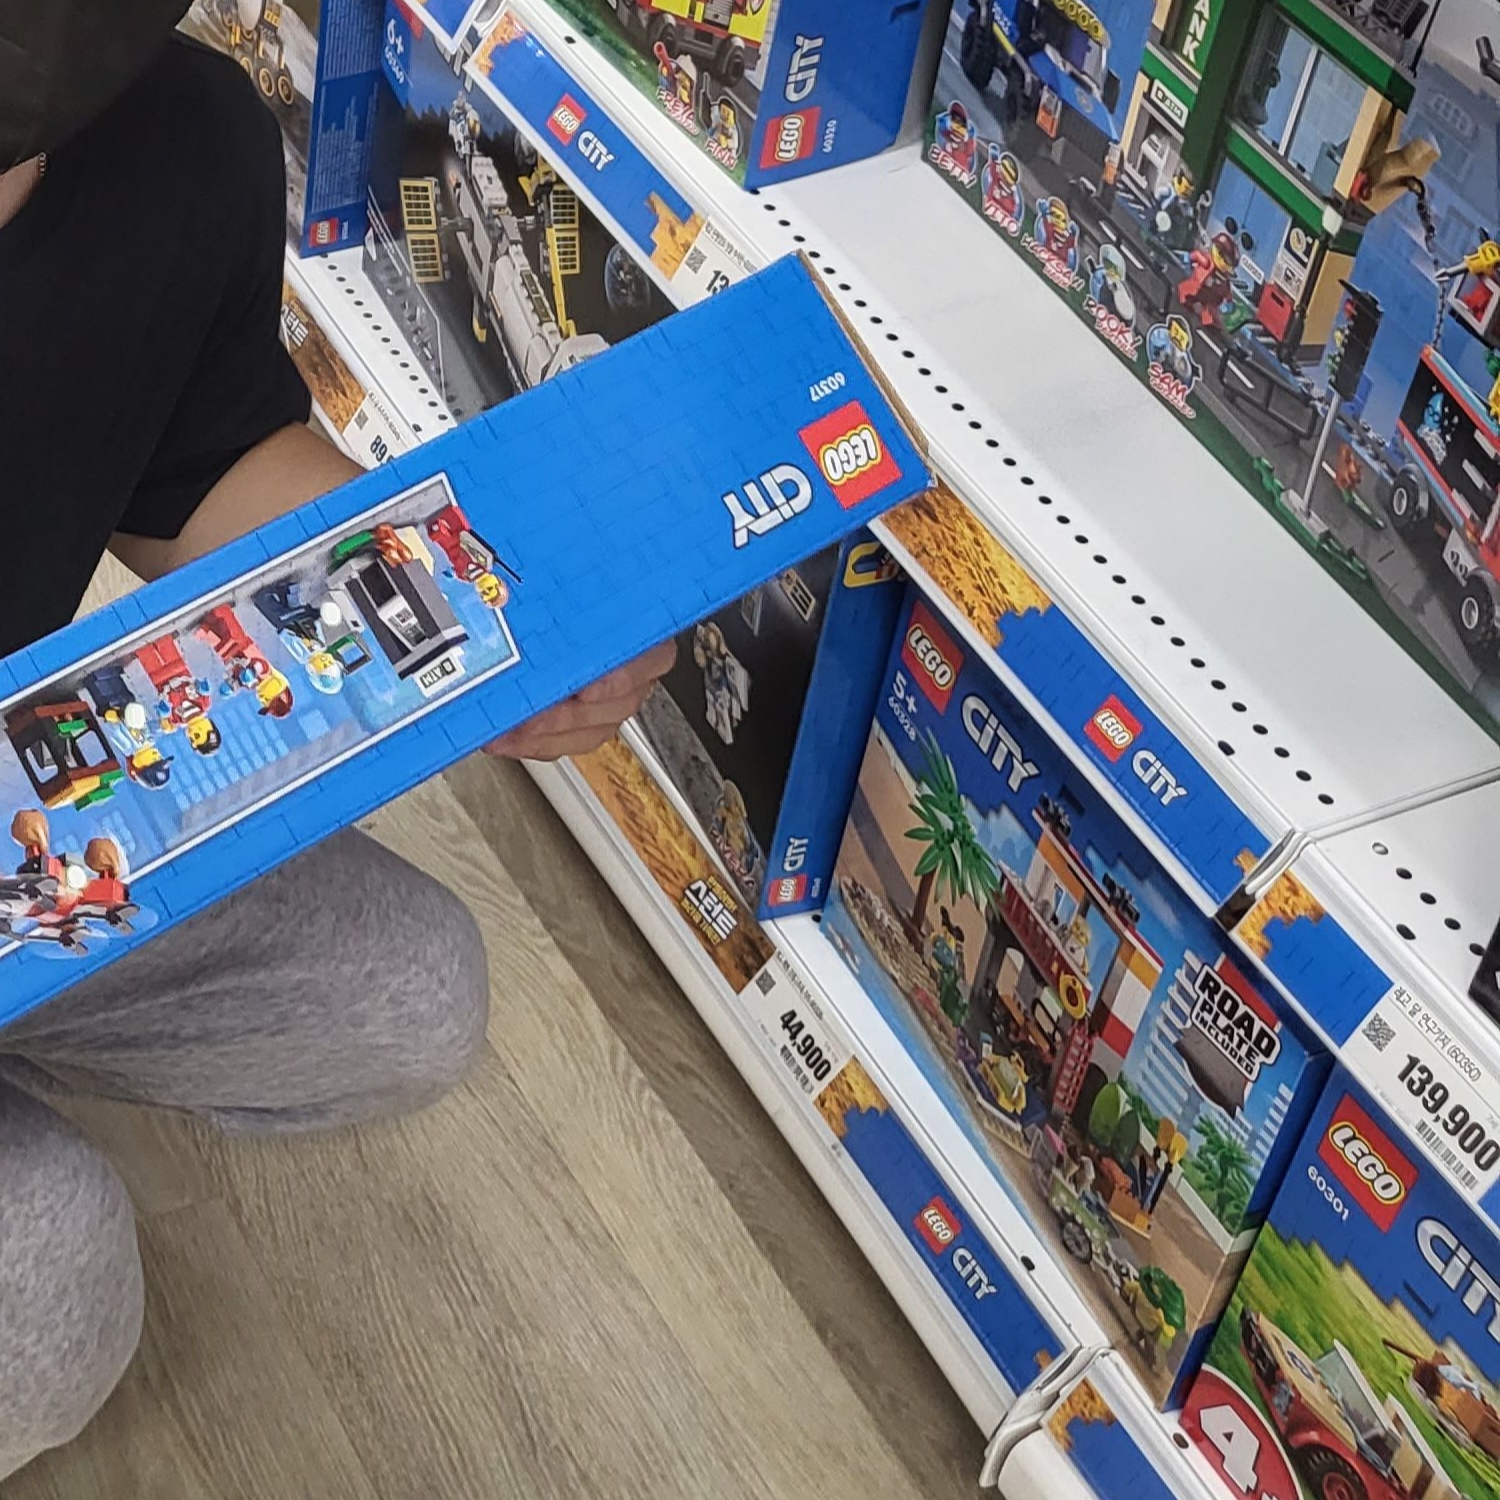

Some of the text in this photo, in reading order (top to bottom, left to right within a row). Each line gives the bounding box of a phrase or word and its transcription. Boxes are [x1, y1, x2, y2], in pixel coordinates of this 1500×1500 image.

[386, 17, 405, 56] 6+
[776, 33, 824, 162] LEGO CITY
[552, 105, 617, 173] LEGO CITY
[821, 118, 838, 154] 60320
[315, 219, 330, 245] LEGO
[809, 371, 846, 402] 60317
[1148, 363, 1188, 400] SAM
[722, 426, 879, 549] LEGO CITY
[891, 670, 918, 714] 5+
[908, 628, 1041, 794] LEGO CITY
[1095, 710, 1133, 746] LEGO
[1131, 748, 1188, 807] CITY
[778, 836, 809, 903] LEGO CITY
[685, 879, 738, 940] 스턴트
[779, 1008, 833, 1082] 44,900
[1194, 1009, 1255, 1076] INCLUDED
[1198, 968, 1278, 1061] ROAD
[1200, 996, 1260, 1068] PLATE
[1393, 985, 1412, 1008] 레고
[1417, 1010, 1453, 1050] 연구기지
[1447, 1041, 1483, 1083] (60350)
[1396, 1053, 1500, 1172] 139,900
[1306, 1163, 1350, 1222] 60301
[1330, 1123, 1403, 1202] LEGO
[923, 1208, 998, 1301] LEGO CITY
